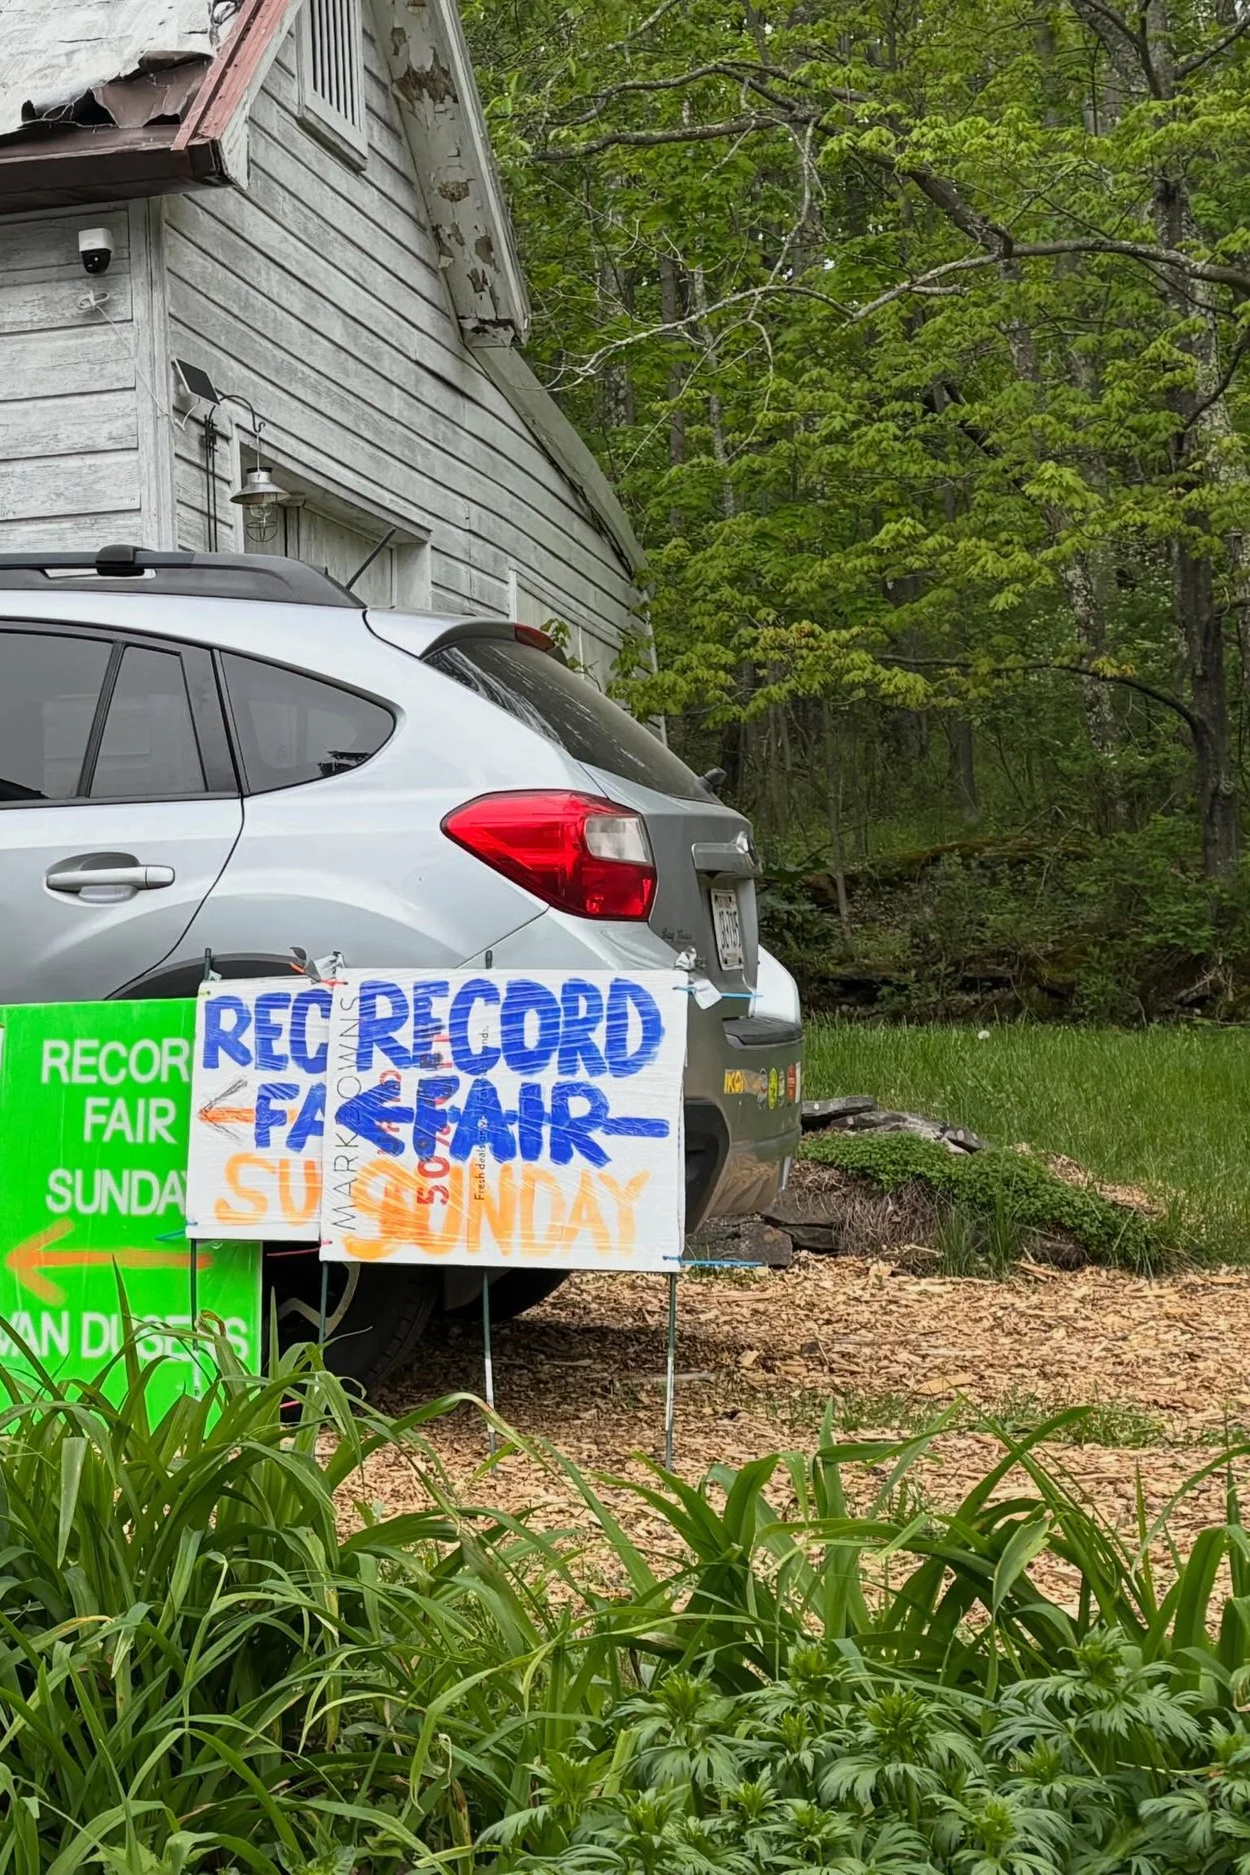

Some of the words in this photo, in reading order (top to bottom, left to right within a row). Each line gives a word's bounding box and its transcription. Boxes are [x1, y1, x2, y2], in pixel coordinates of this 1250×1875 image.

[41, 1038, 191, 1087] RECOR
[203, 991, 332, 1075] REC
[355, 978, 666, 1079] RECORD
[83, 1096, 178, 1145] FAIR
[254, 1082, 326, 1152] FA
[332, 996, 362, 1231] MARKOWNS
[411, 1075, 613, 1168] FAIR
[45, 1167, 187, 1218] SUNDA
[342, 1156, 652, 1260] SUNDAY
[474, 1172, 486, 1201] Fresh
